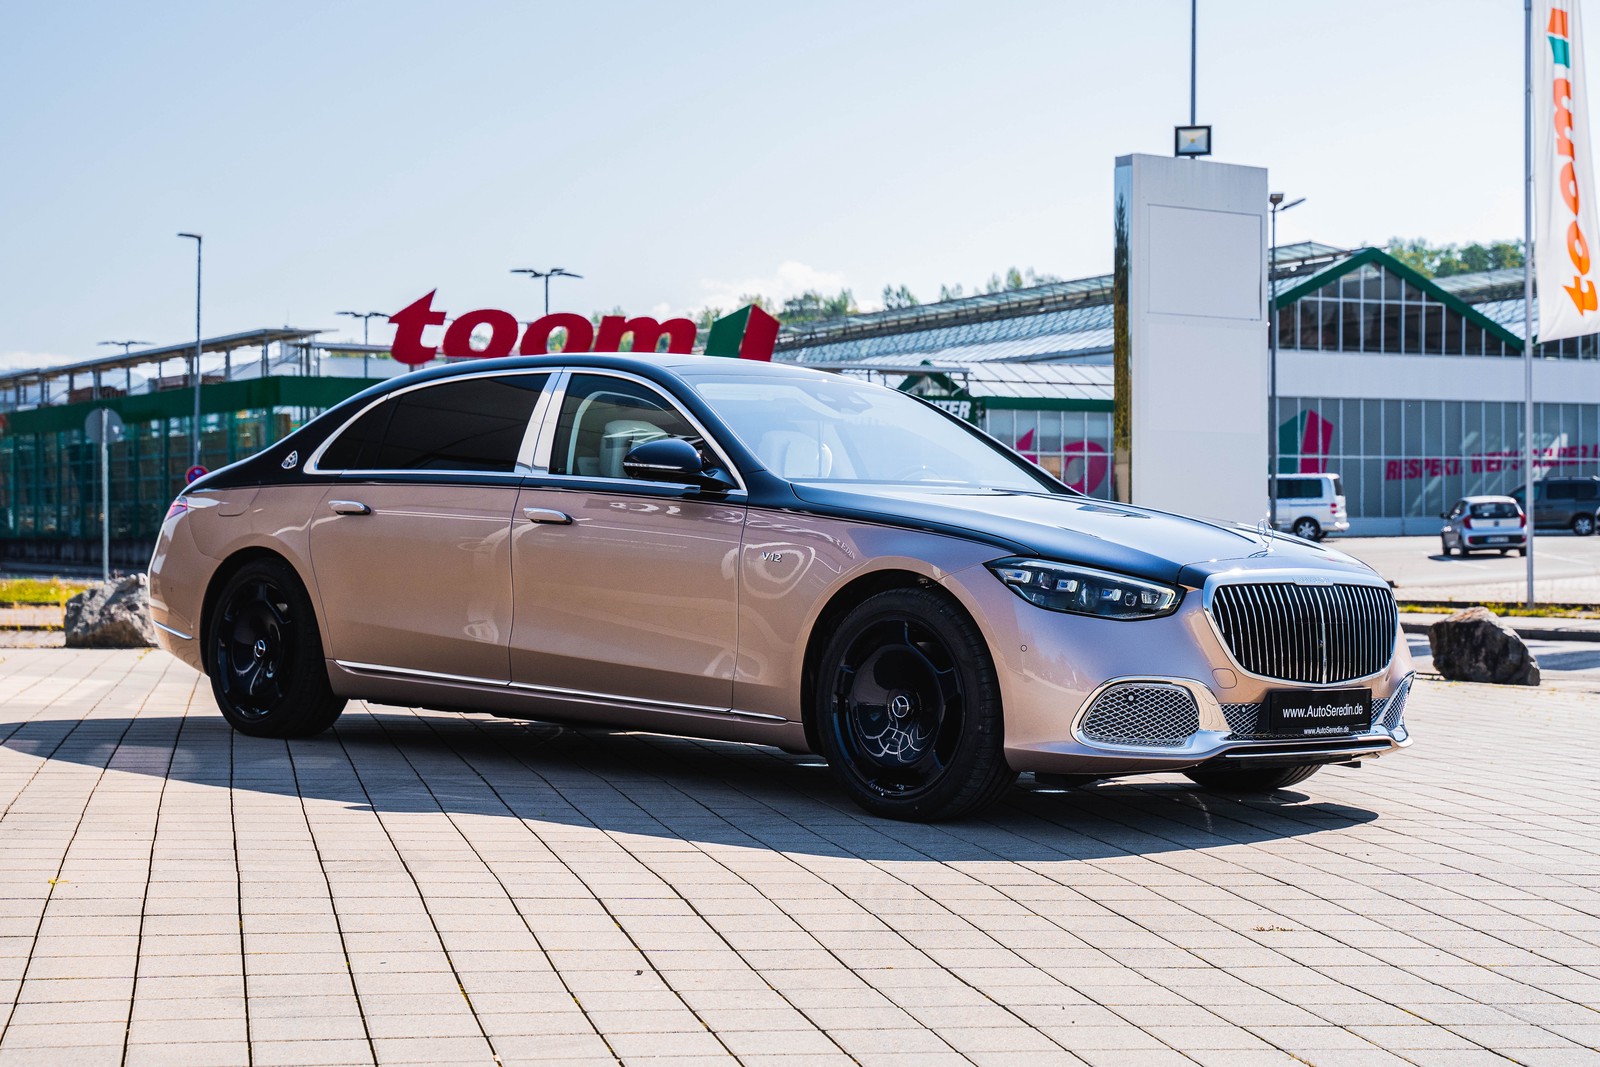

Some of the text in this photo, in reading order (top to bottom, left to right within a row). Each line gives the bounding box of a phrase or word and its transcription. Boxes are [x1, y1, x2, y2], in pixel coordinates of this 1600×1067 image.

[1553, 78, 1598, 317] toom
[388, 289, 697, 365] toom
[762, 551, 782, 562] V12
[1283, 703, 1363, 718] www.AutoSeredin.de
[1304, 726, 1349, 735] www.AutoSeredin.de
